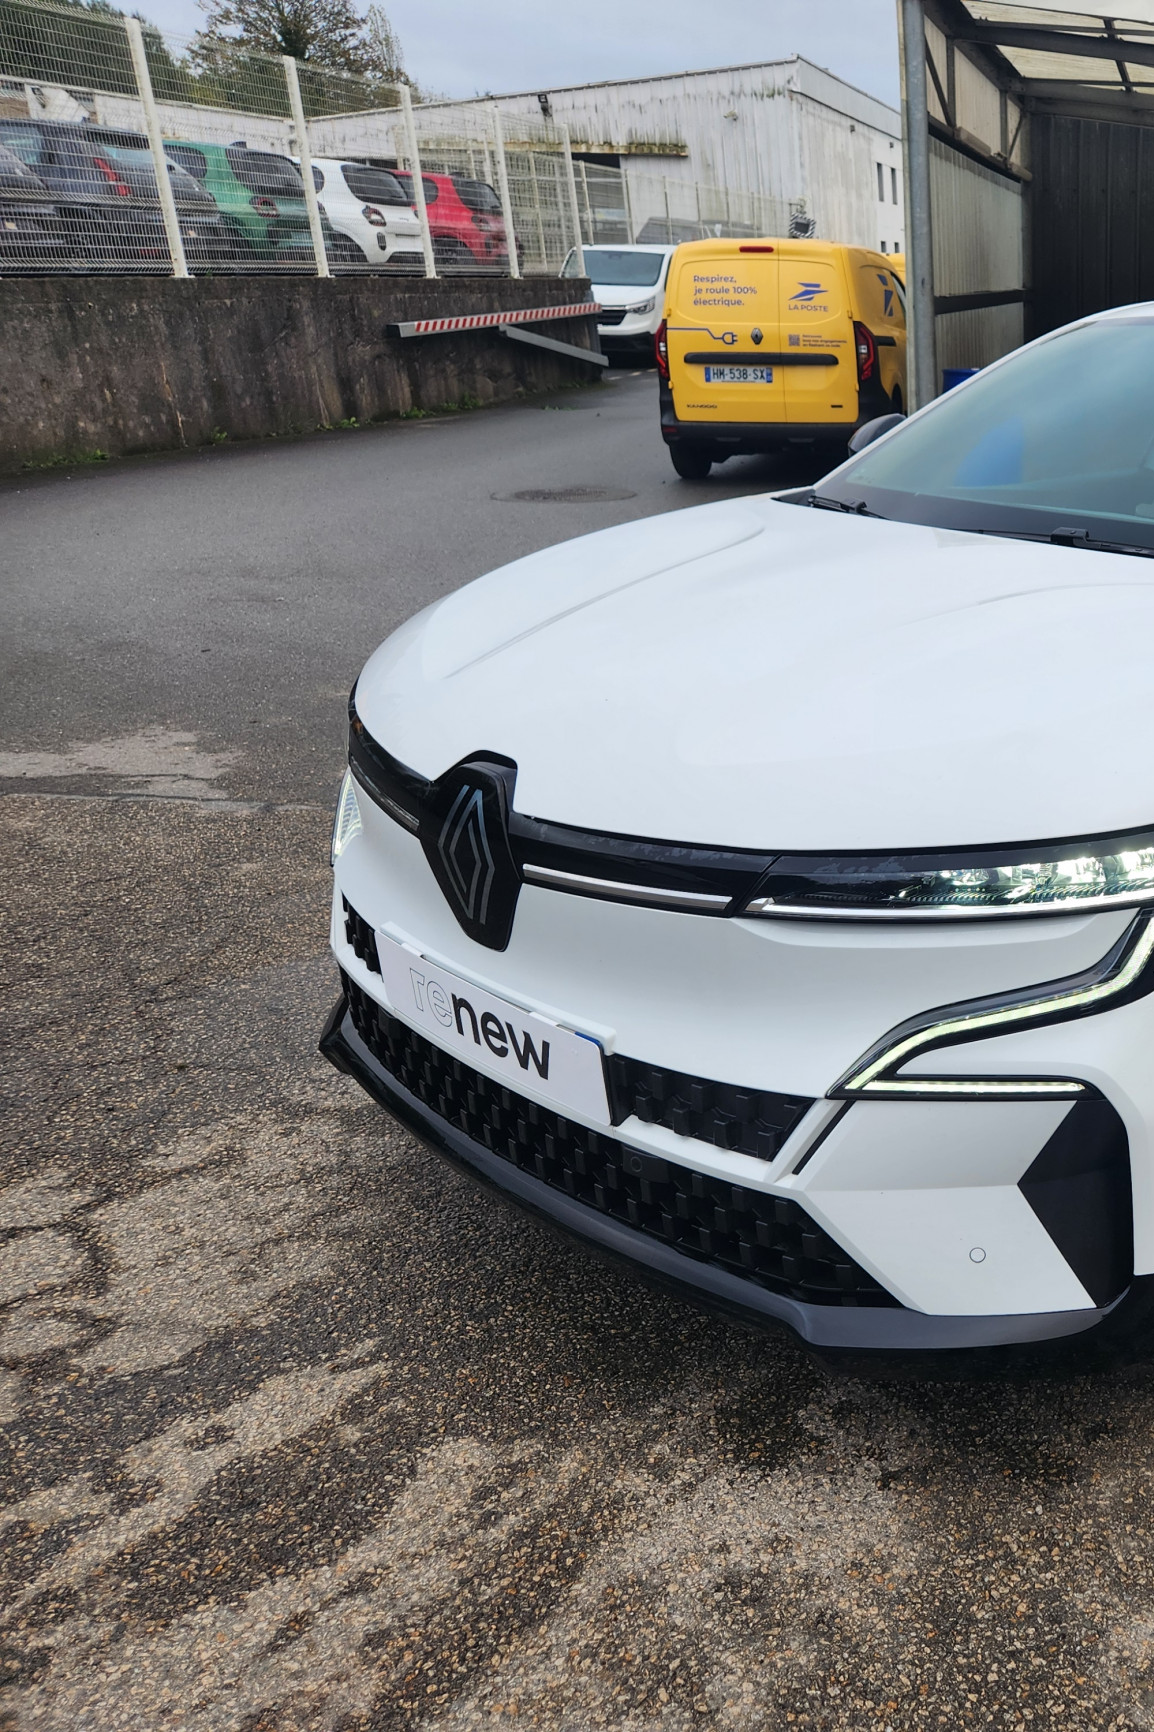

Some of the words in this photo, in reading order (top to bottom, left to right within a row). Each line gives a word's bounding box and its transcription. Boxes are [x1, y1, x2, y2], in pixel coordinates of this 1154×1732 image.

[693, 274, 737, 284] Respirez,
[694, 286, 703, 296] je
[705, 286, 730, 294] roule
[732, 286, 758, 295] 100%
[693, 296, 745, 307] électrique.
[801, 304, 829, 312] POSTE
[409, 967, 551, 1081] renew
